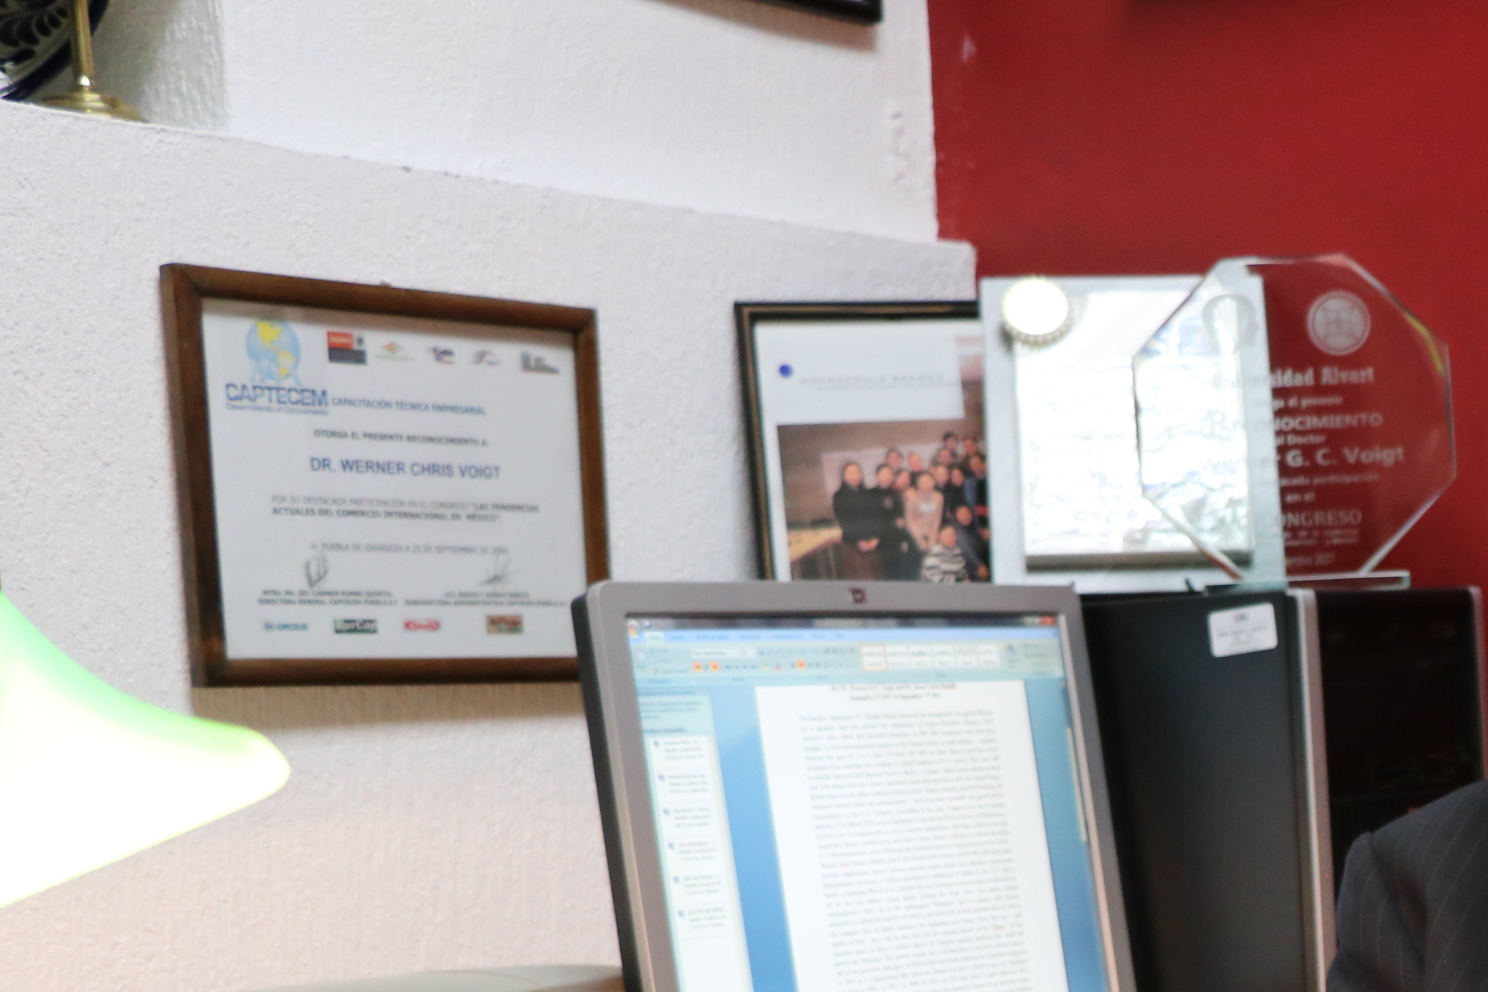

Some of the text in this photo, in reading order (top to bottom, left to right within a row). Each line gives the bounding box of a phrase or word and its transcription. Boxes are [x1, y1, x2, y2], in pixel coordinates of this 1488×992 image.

[225, 383, 329, 407] CAPTECEM
[395, 400, 430, 412] TÉCNICA
[431, 404, 486, 415] EMPRESARIAL
[314, 429, 348, 439] OTORGA
[363, 432, 404, 442] PRESENTE
[406, 434, 479, 447] RECONOCIMIENTO
[1287, 434, 1326, 447] Doctor
[1285, 449, 1310, 468] G.
[1315, 449, 1338, 467] C.
[1342, 446, 1405, 469] Voigt
[311, 457, 501, 479] DR. WERNER CHRIS VOIGT
[272, 507, 316, 517] ACTUALES
[318, 508, 334, 517] DEL
[336, 508, 381, 518] COMERCIO
[383, 510, 449, 521] INTERNACIONAL
[1281, 509, 1362, 528] ONGRESO
